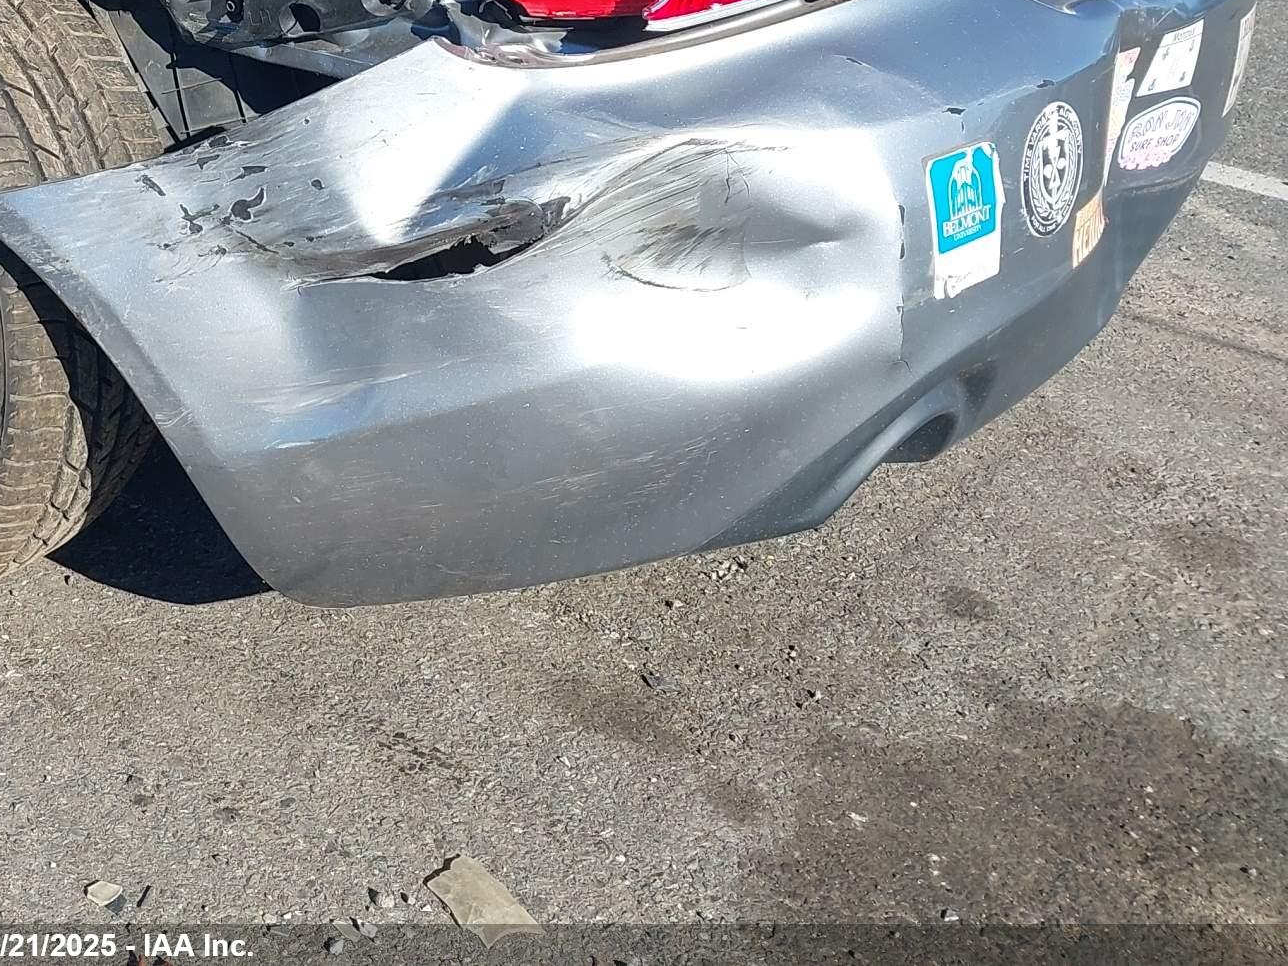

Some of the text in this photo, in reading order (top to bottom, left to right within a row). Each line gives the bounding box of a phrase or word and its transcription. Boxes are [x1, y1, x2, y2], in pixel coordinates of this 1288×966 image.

[1130, 134, 1180, 152] SURF SHOP
[1023, 147, 1033, 181] TIME
[943, 204, 991, 237] BELMONT
[953, 225, 982, 241] UNIVERSITY
